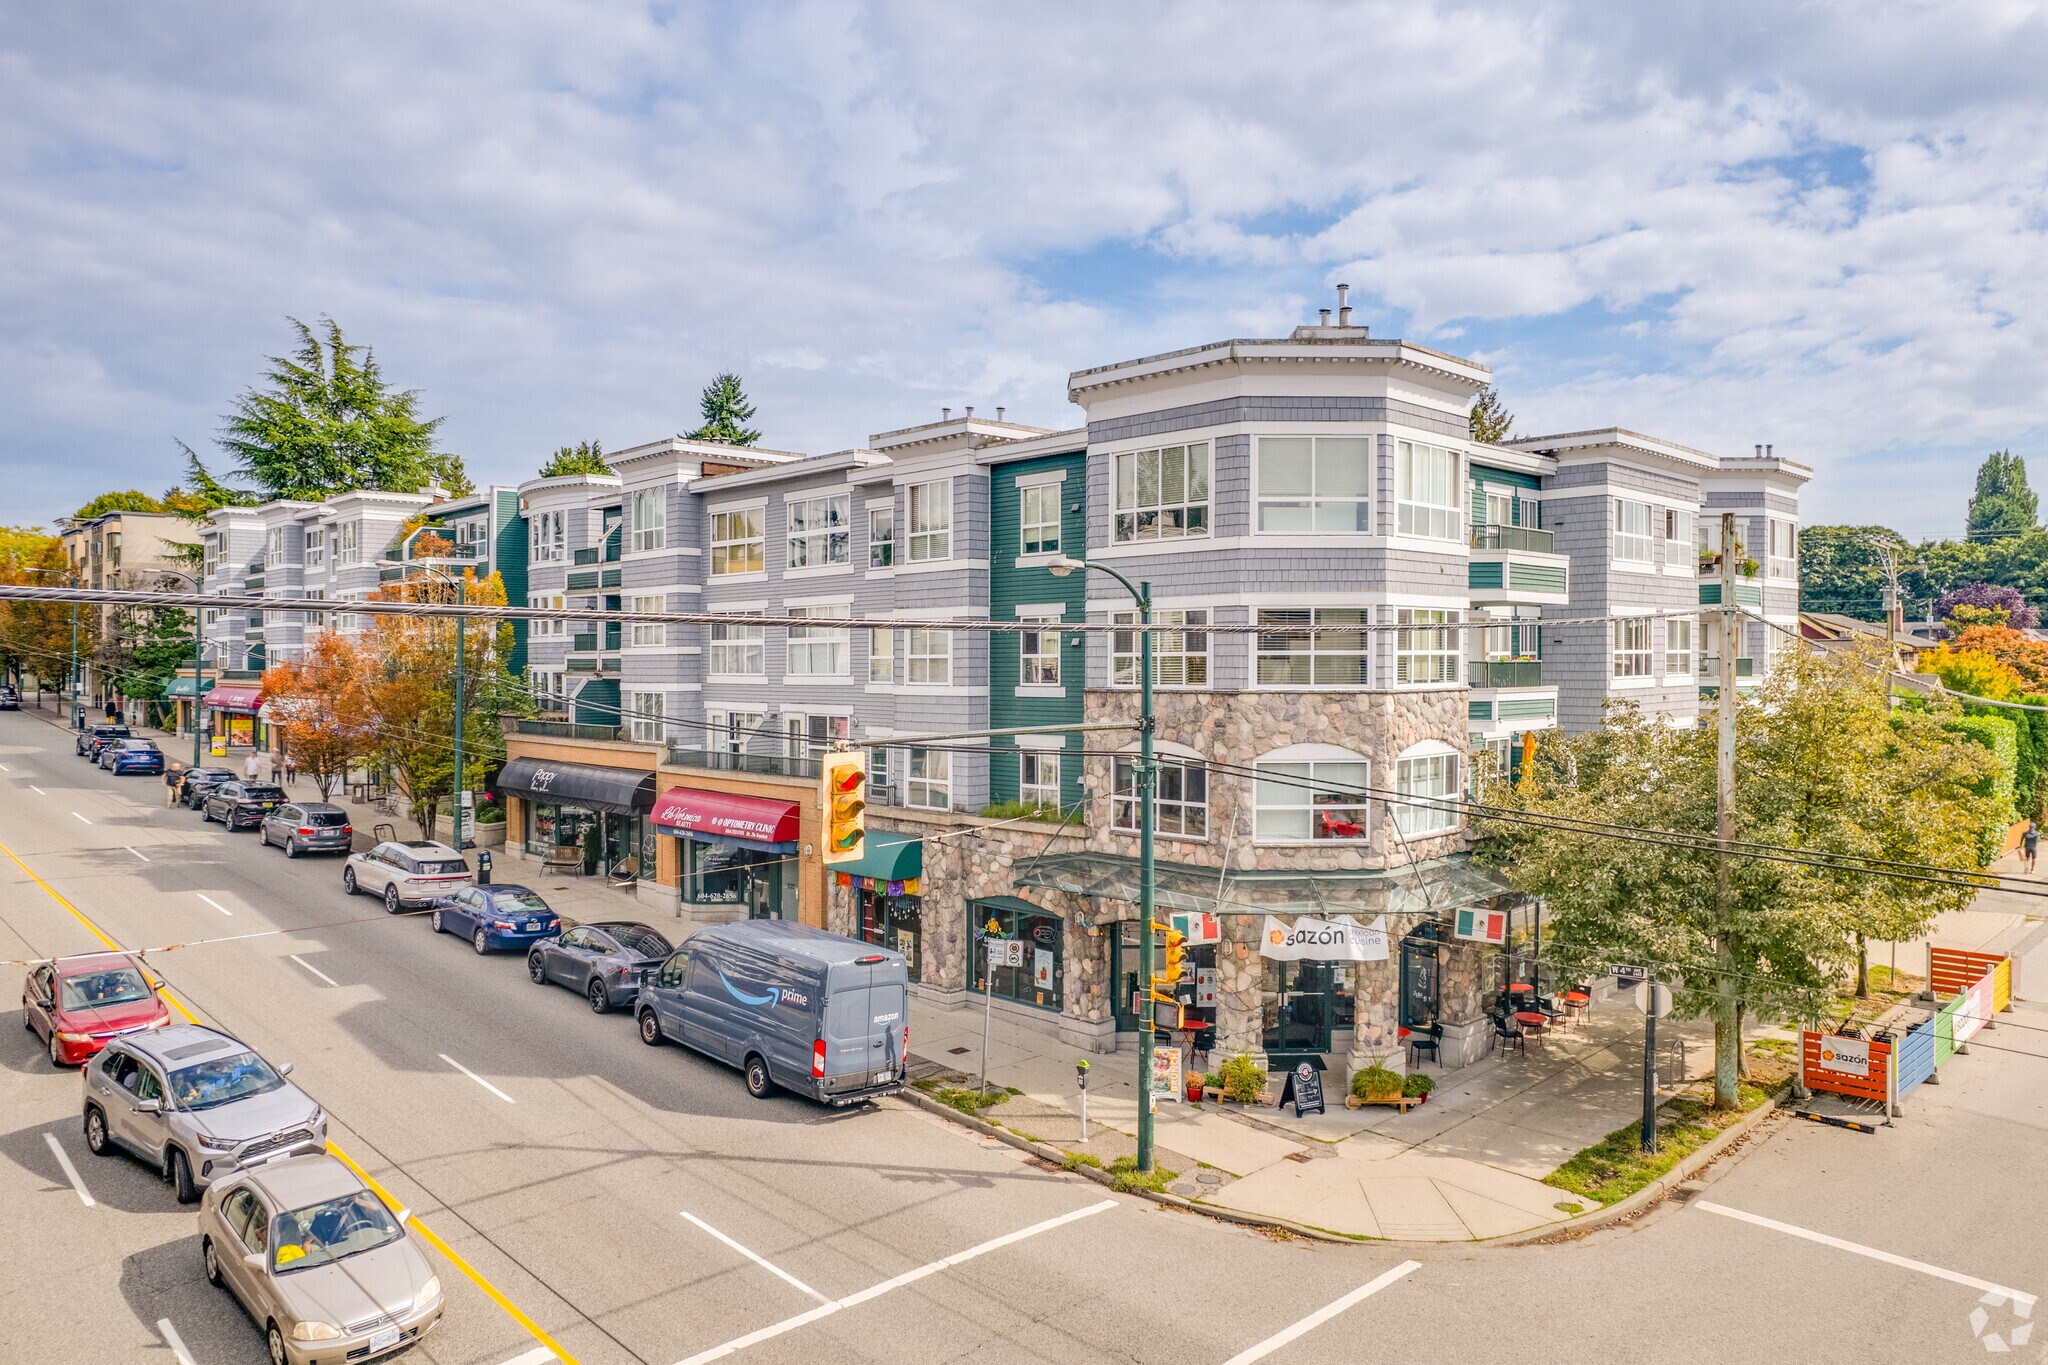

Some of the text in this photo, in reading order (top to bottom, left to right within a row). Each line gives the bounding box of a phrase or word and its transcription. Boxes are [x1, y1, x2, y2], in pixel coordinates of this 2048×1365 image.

[722, 818, 756, 831] OPTOMETRY
[755, 822, 776, 834] CLINIC
[1033, 926, 1056, 940] OPEN
[1286, 926, 1344, 946] sazón
[1350, 937, 1381, 946] cuisine
[781, 988, 808, 1006] prime
[873, 1012, 899, 1023] amazon
[1835, 1053, 1868, 1065] sazón
[1170, 1053, 1178, 1093] BRUNCH
